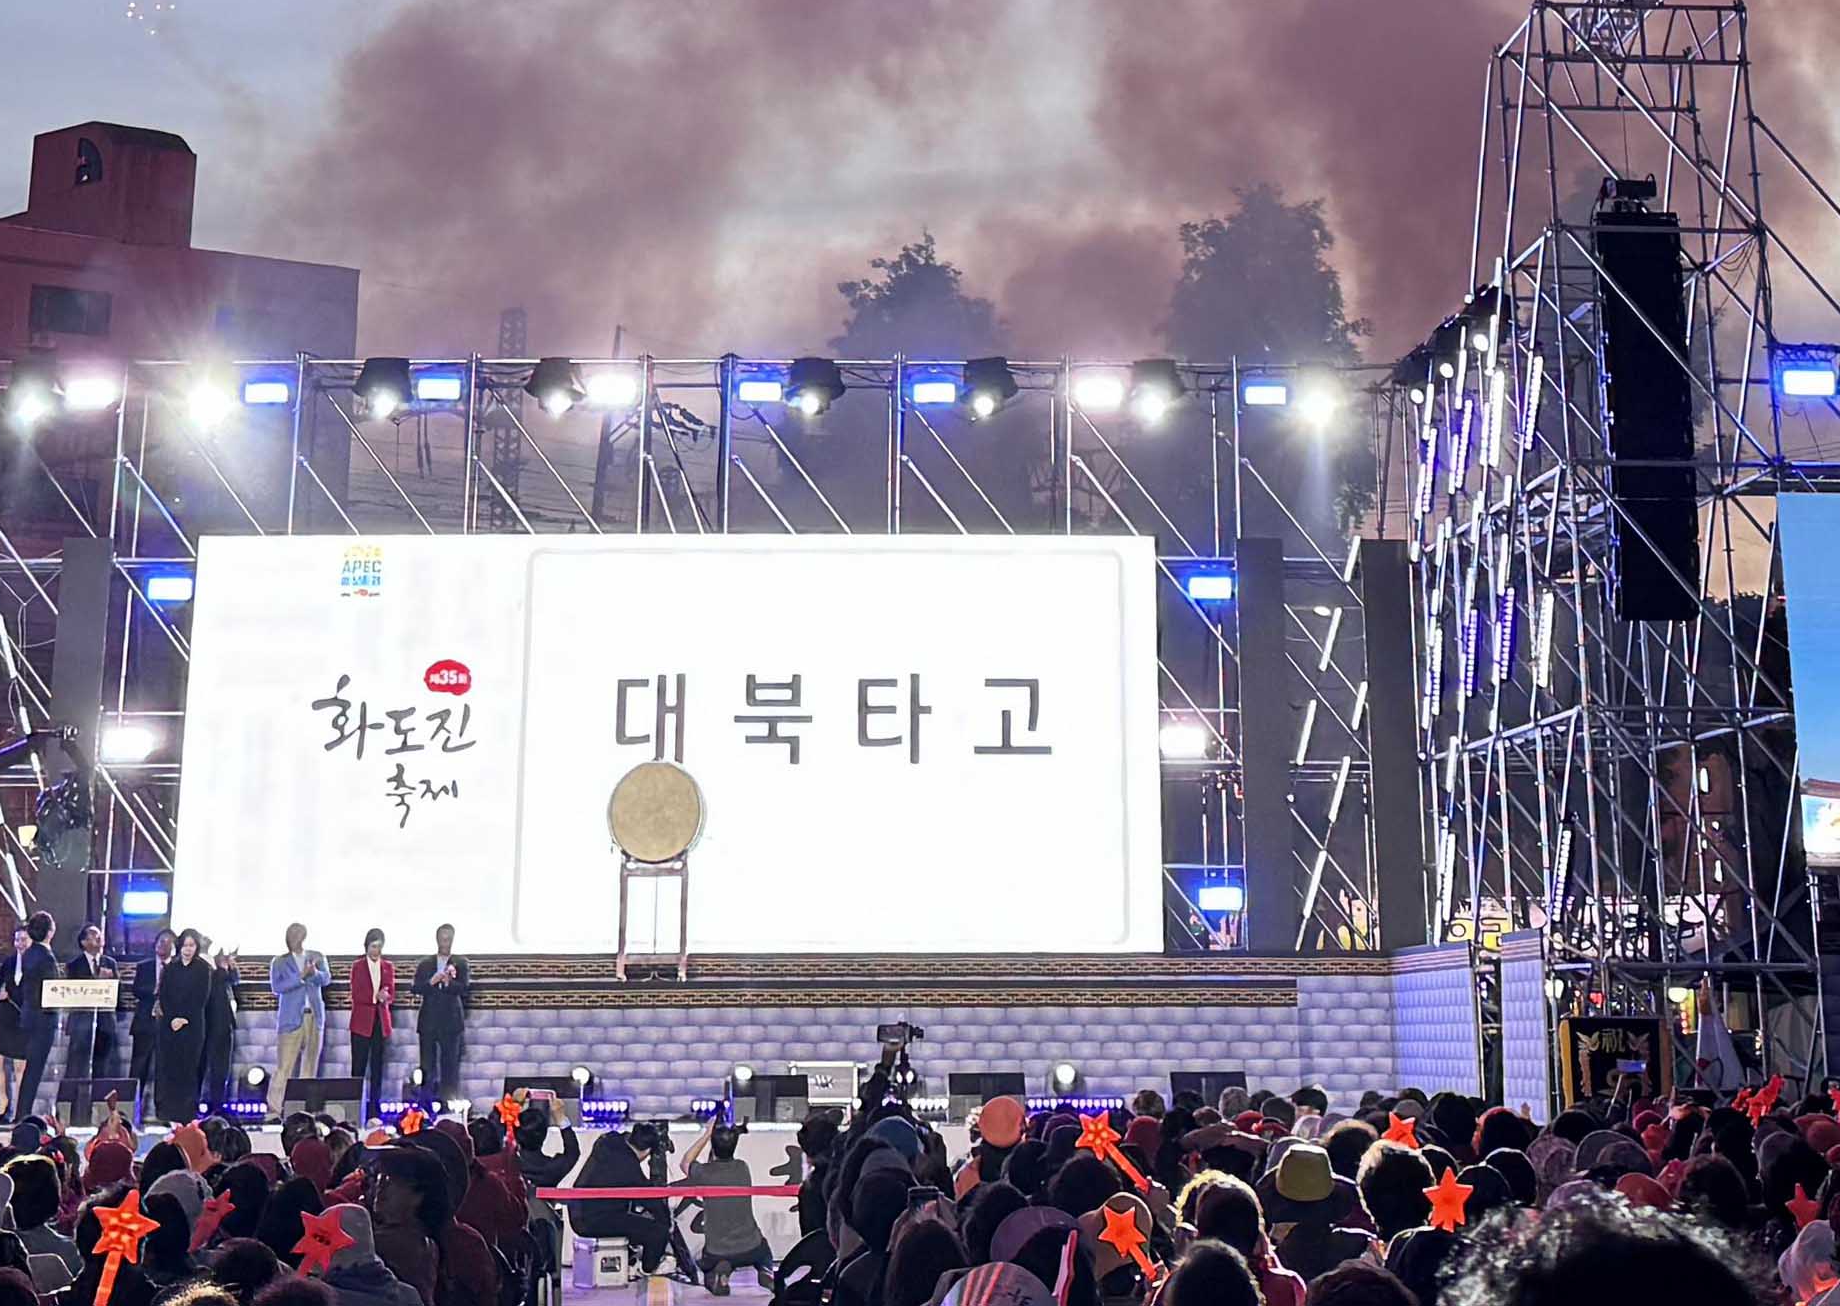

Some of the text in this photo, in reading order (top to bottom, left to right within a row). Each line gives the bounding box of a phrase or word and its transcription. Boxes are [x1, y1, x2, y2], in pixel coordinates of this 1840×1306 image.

[342, 559, 383, 574] APEC
[311, 673, 477, 761] 화도진
[385, 762, 459, 829] 축제
